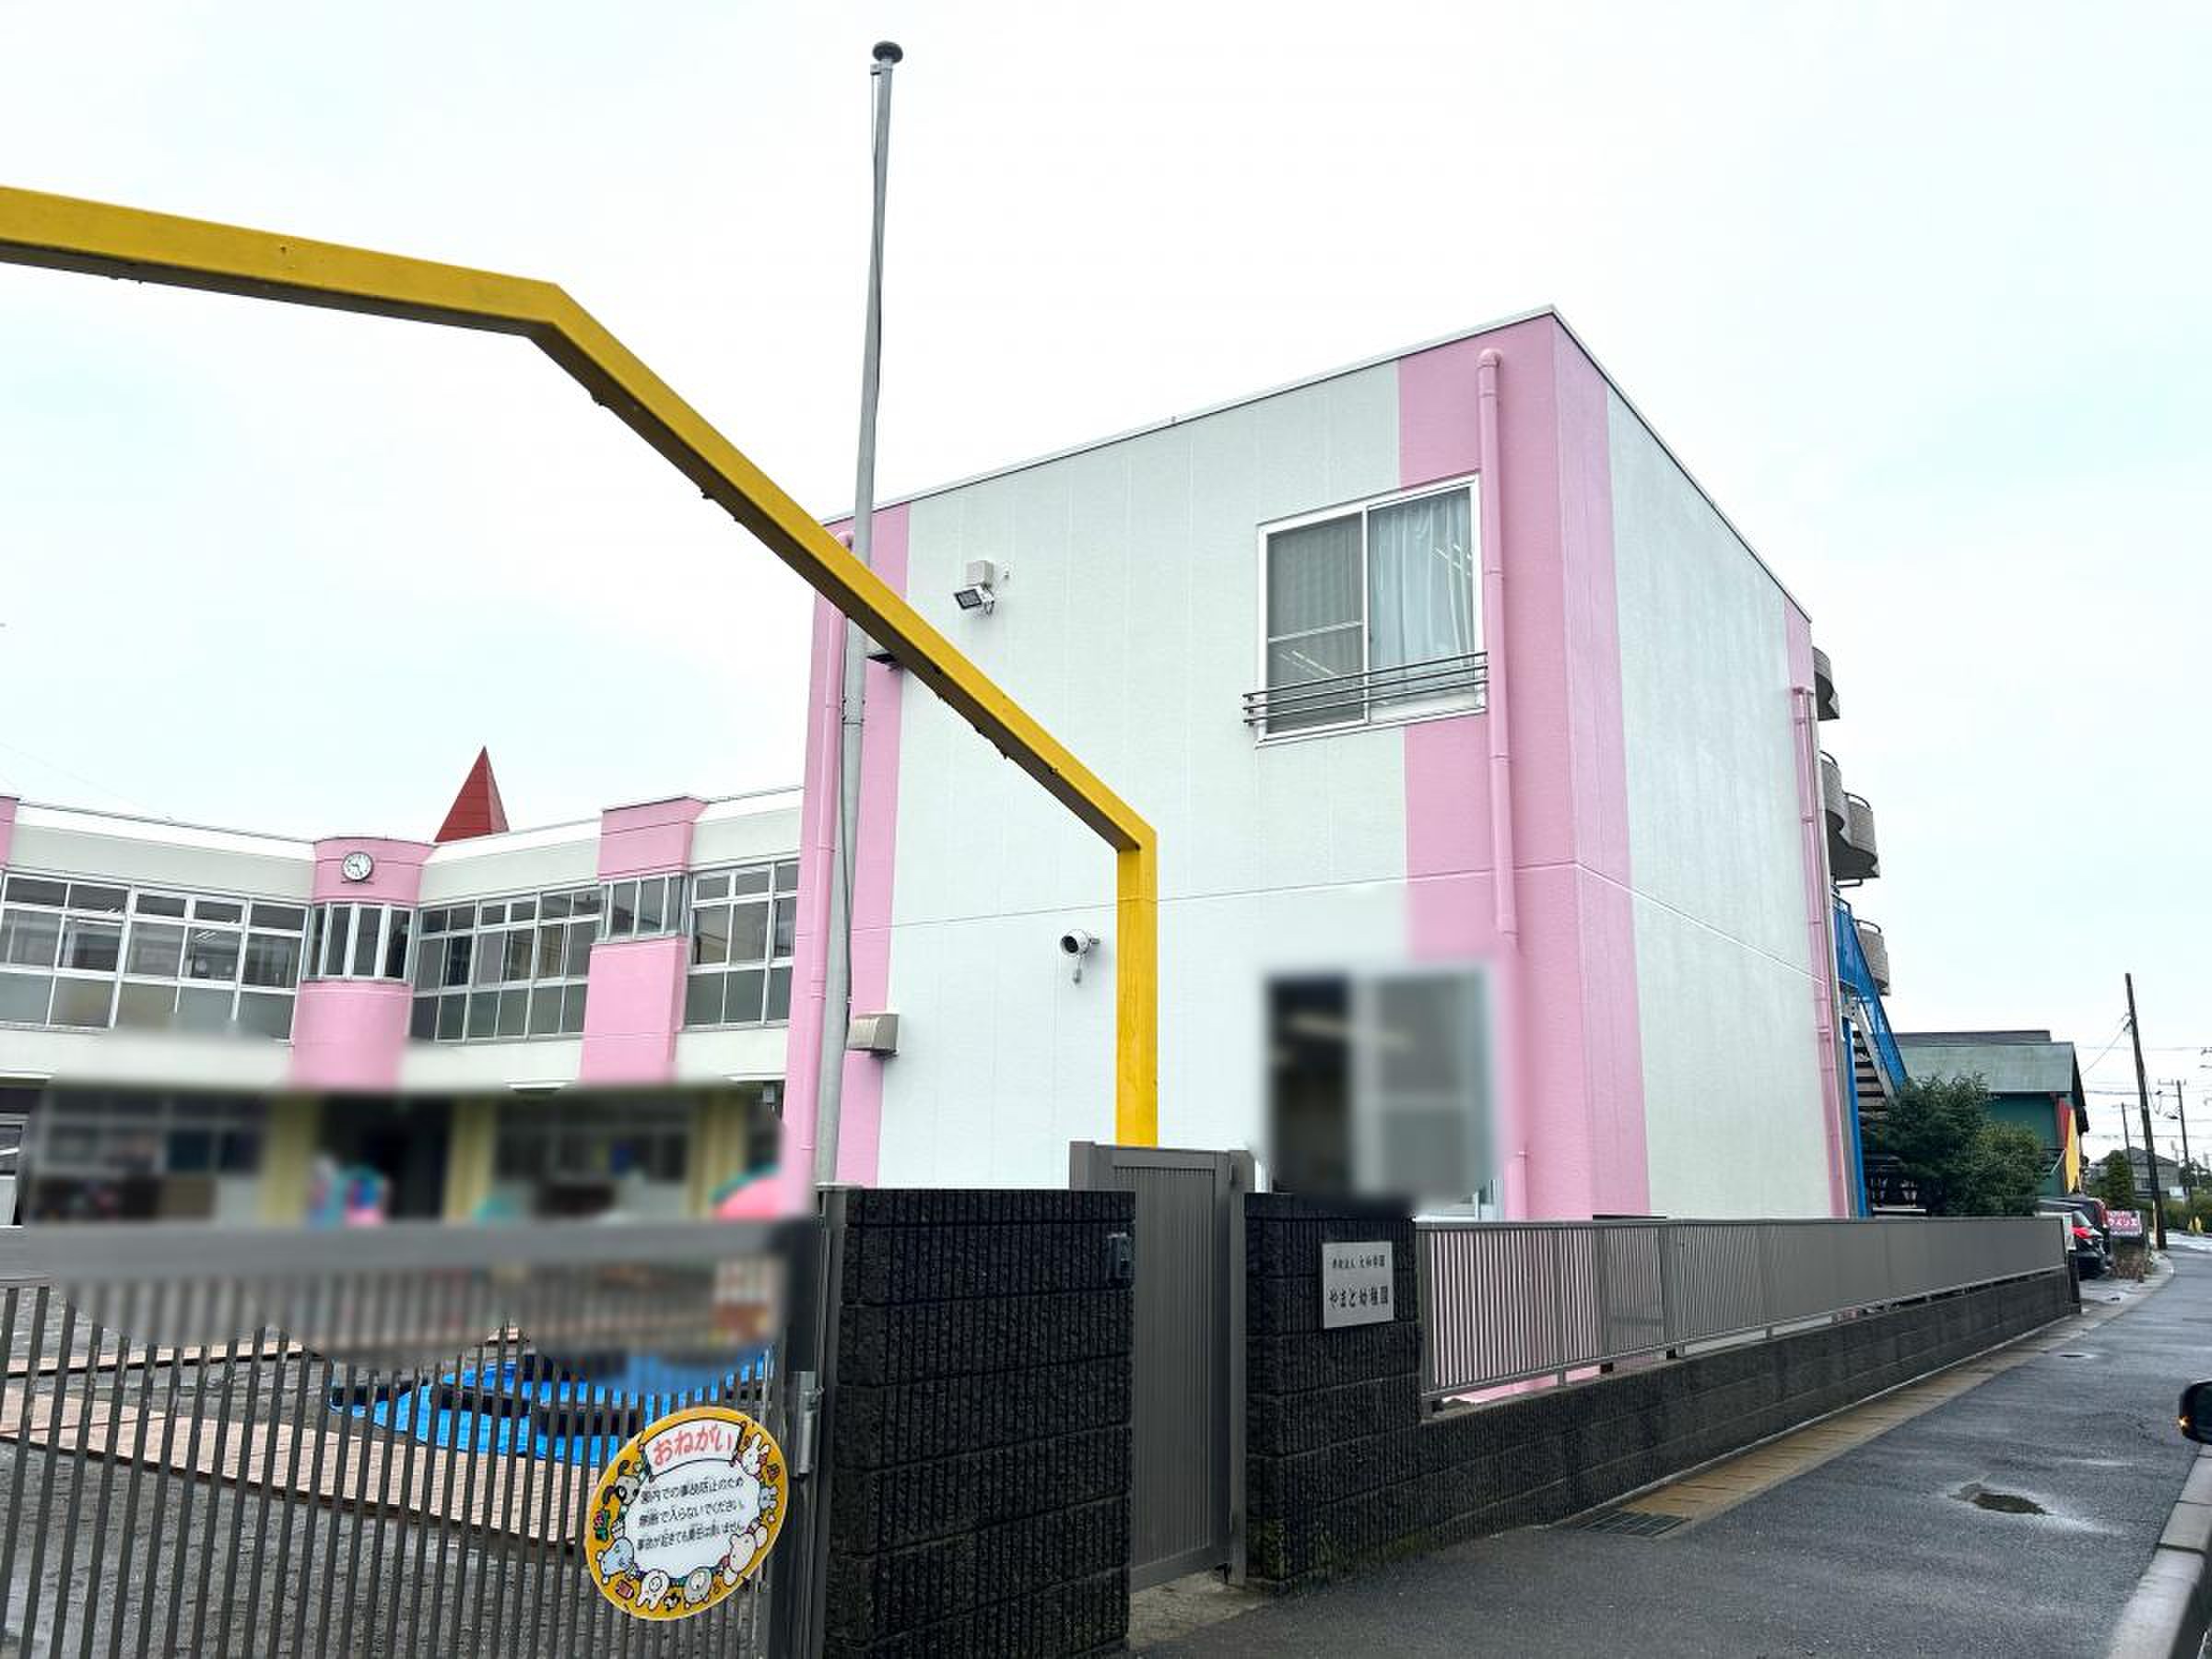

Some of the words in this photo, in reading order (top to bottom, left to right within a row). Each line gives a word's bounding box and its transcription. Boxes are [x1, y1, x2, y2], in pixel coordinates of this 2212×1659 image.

[1329, 1286, 1388, 1309] やまと幼稚園
[653, 1425, 732, 1465] おねがい
